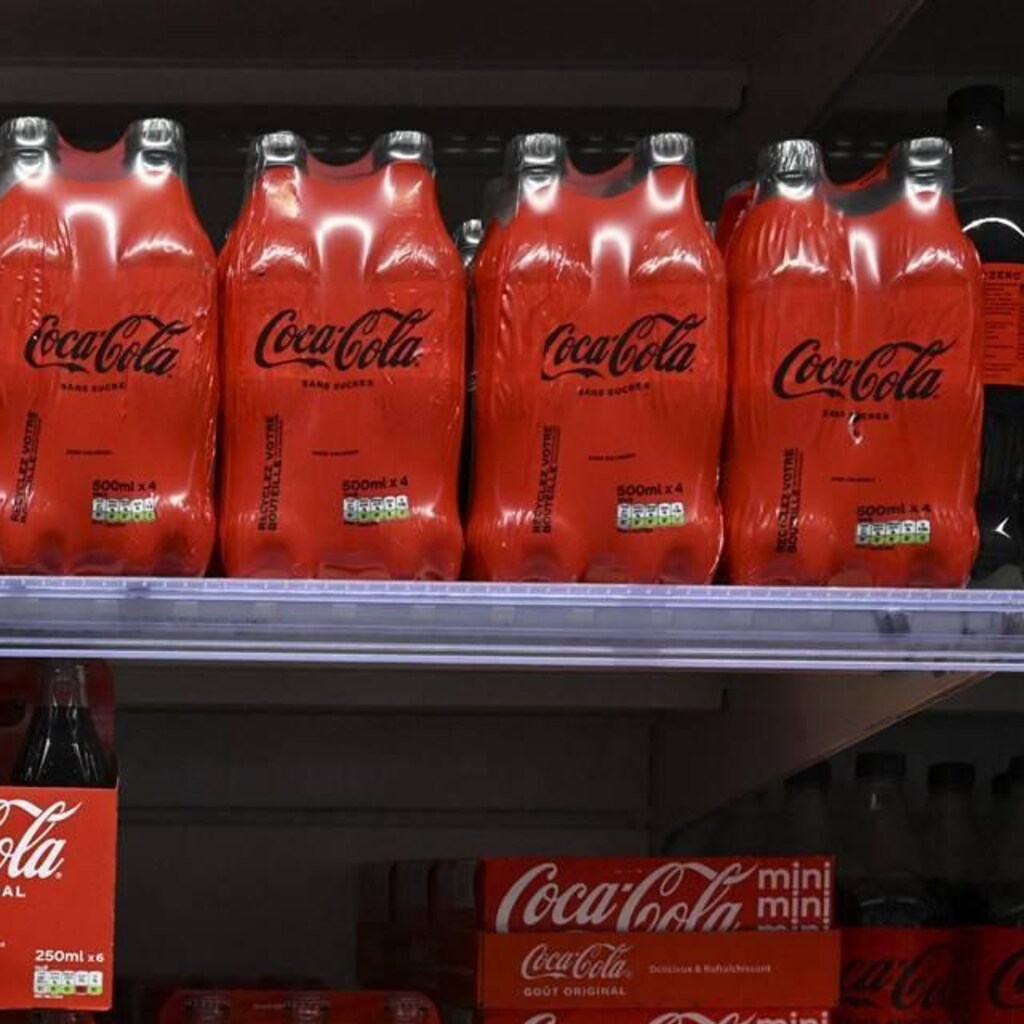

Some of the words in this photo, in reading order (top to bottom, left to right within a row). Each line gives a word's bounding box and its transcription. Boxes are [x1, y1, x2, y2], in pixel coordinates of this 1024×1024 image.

[25, 313, 192, 378] Coca-Cola
[254, 306, 433, 371] Coca-Cola
[541, 312, 707, 382] Coca-Cola
[772, 338, 957, 401] Coca-Cola
[93, 479, 135, 492] 500ml
[147, 480, 157, 492] 4
[343, 478, 386, 493] 500ml
[398, 476, 408, 490] 4
[617, 484, 662, 497] 500ml
[673, 484, 684, 495] 4
[856, 504, 904, 517] 500ml
[918, 503, 931, 515] 4
[495, 861, 758, 933] Coca-Cola
[757, 861, 831, 889] mini
[757, 891, 831, 919] mini
[35, 949, 84, 963] 250ml
[521, 942, 635, 981] Coca-Cola
[523, 984, 560, 997] GOÛT
[563, 986, 627, 997] ORIGINAL
